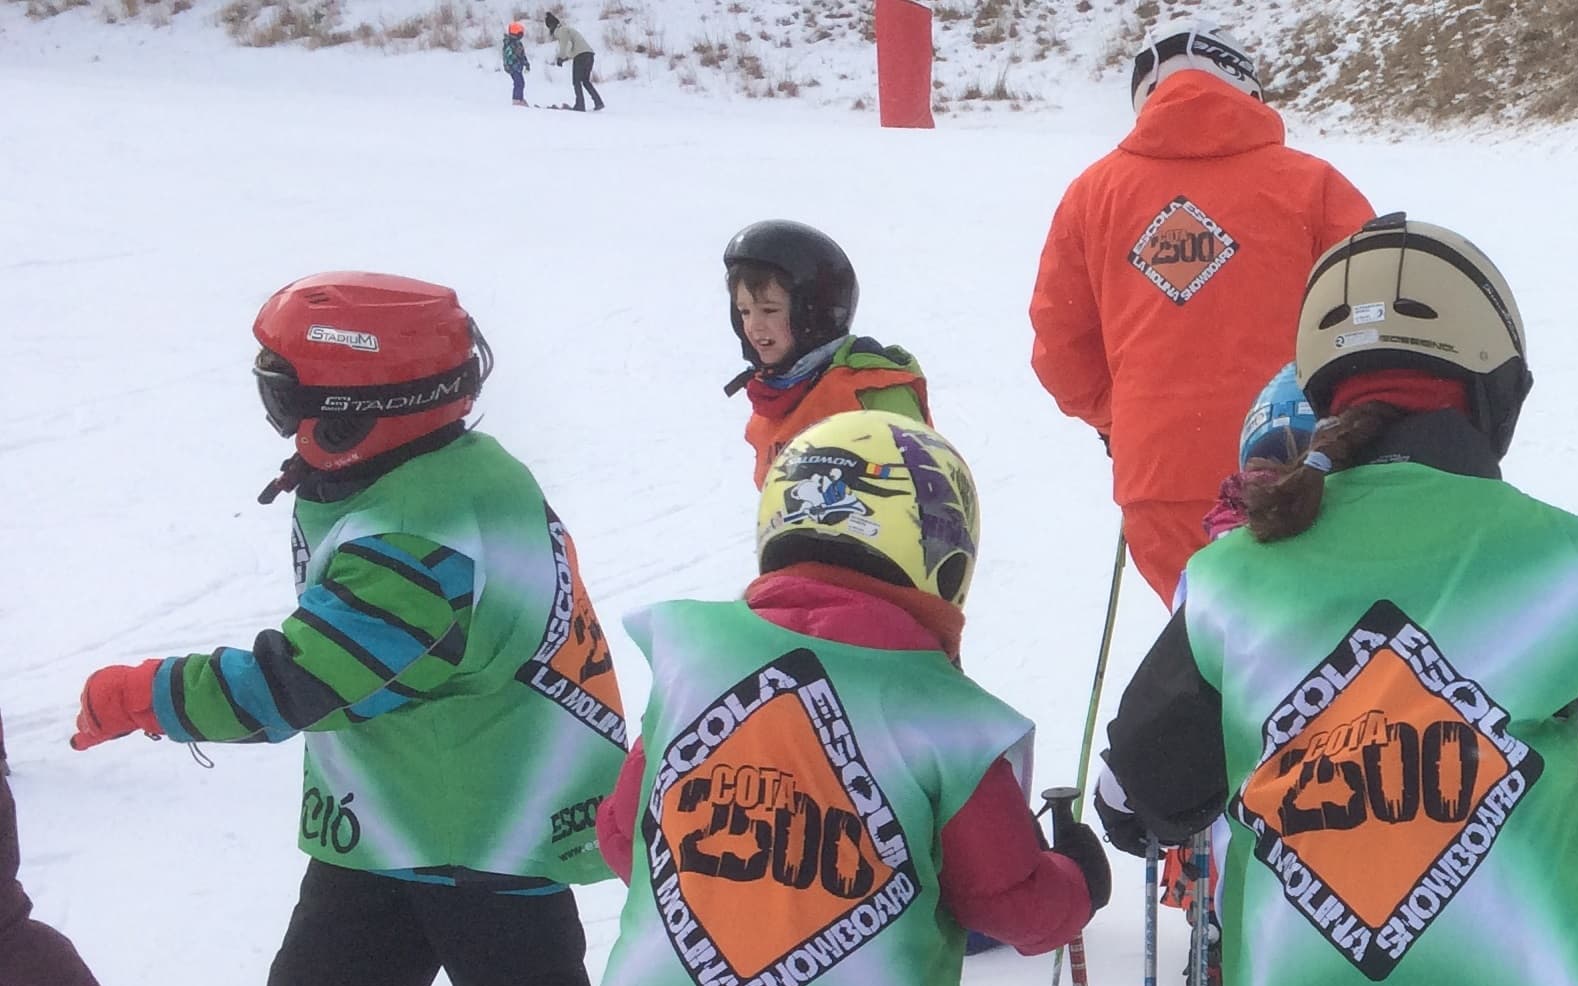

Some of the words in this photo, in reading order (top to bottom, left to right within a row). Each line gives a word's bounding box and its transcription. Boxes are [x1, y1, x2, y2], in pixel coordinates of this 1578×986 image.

[1133, 202, 1181, 255] ESCOLA
[1150, 231, 1214, 264] 2500
[1183, 201, 1233, 246] ESQUI
[1133, 256, 1146, 271] LA
[1145, 267, 1180, 301] MOLINA
[1180, 247, 1235, 300] SNOWBOARD
[311, 328, 373, 347] STADIUM
[321, 376, 462, 412] STADIUM
[789, 455, 858, 468] SALOMON
[531, 666, 564, 700] LA
[1307, 710, 1390, 764] COTA
[710, 763, 798, 815] COTA
[798, 677, 909, 869] ESQUI
[1276, 720, 1480, 837] 2500
[550, 794, 604, 844] ESCO
[677, 777, 875, 900] 2500
[1376, 769, 1526, 960] SNOWBOARD
[1266, 837, 1373, 962] MOLINA
